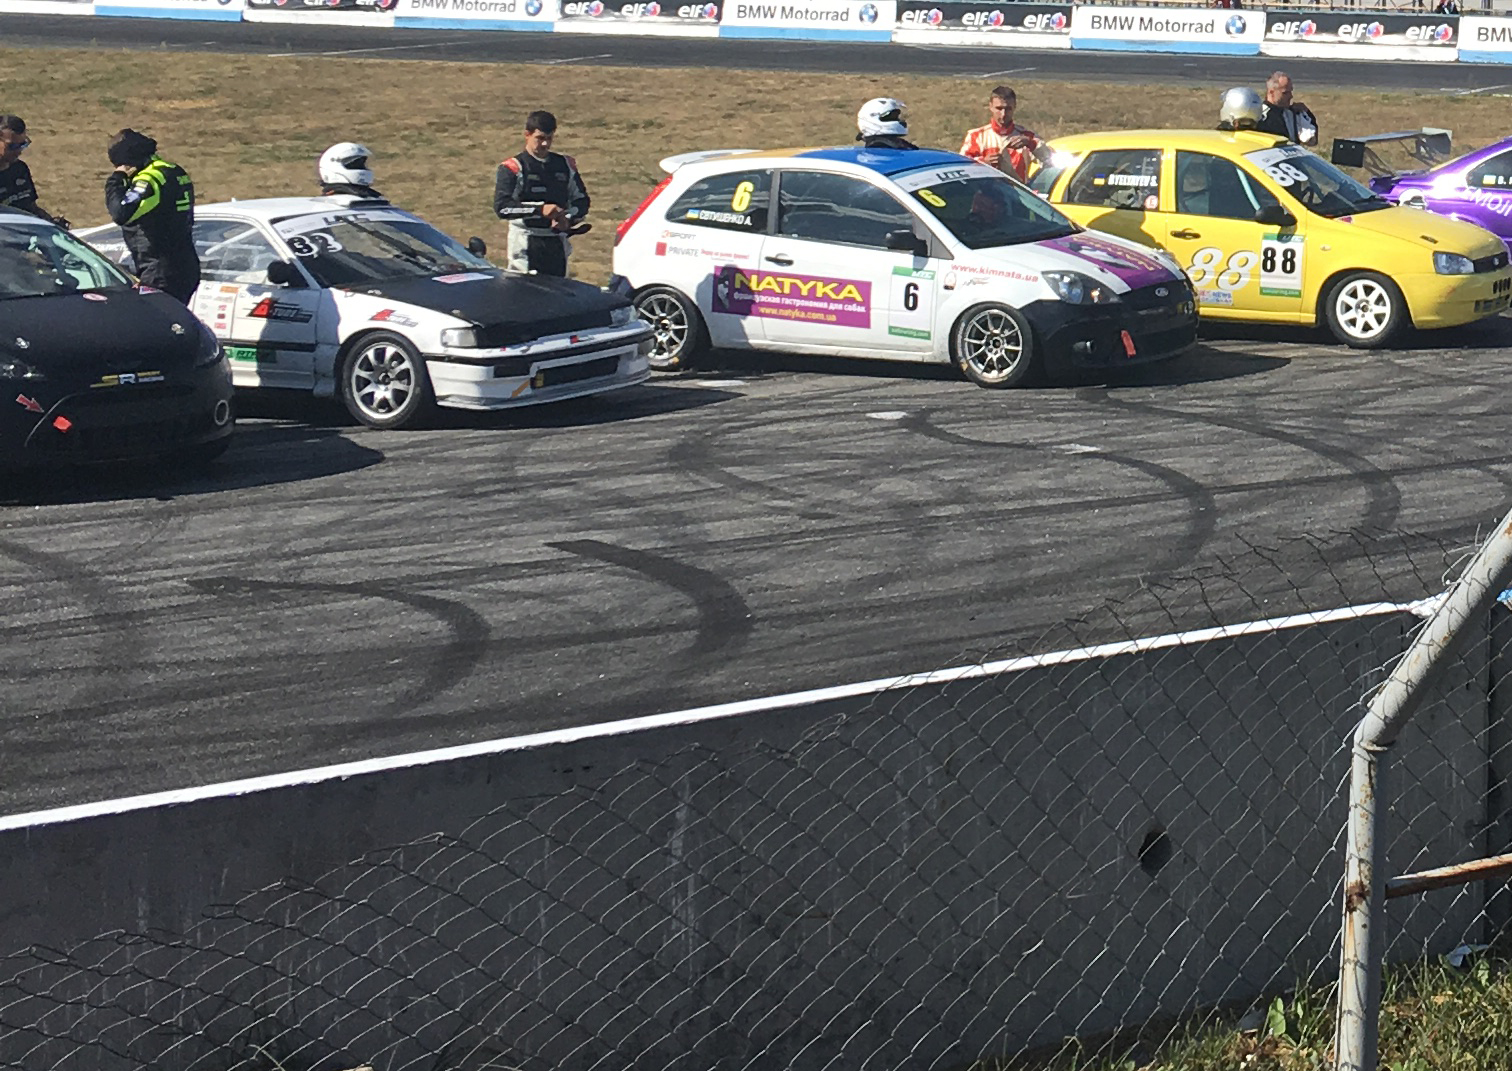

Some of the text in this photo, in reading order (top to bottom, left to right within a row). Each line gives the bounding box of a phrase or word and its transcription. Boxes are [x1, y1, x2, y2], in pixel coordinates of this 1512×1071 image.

[565, 2, 589, 15] elf
[621, 3, 646, 17] elf
[678, 4, 703, 18] elf
[736, 4, 849, 23] BMW Motorrad
[902, 9, 927, 24] elf
[962, 10, 989, 26] elf
[1023, 13, 1051, 29] elf
[1091, 15, 1214, 34] BMW Motorrad
[1271, 20, 1299, 36] elf
[1338, 22, 1367, 39] elf
[1405, 25, 1435, 41] elf
[1265, 163, 1308, 186] 88
[731, 181, 754, 212] 6
[918, 189, 947, 207] 6
[1186, 246, 1258, 290] 88
[1262, 247, 1296, 274] 88
[734, 272, 863, 302] NATYKA
[904, 282, 919, 311] 6
[828, 302, 843, 310] для
[844, 304, 866, 313] собак
